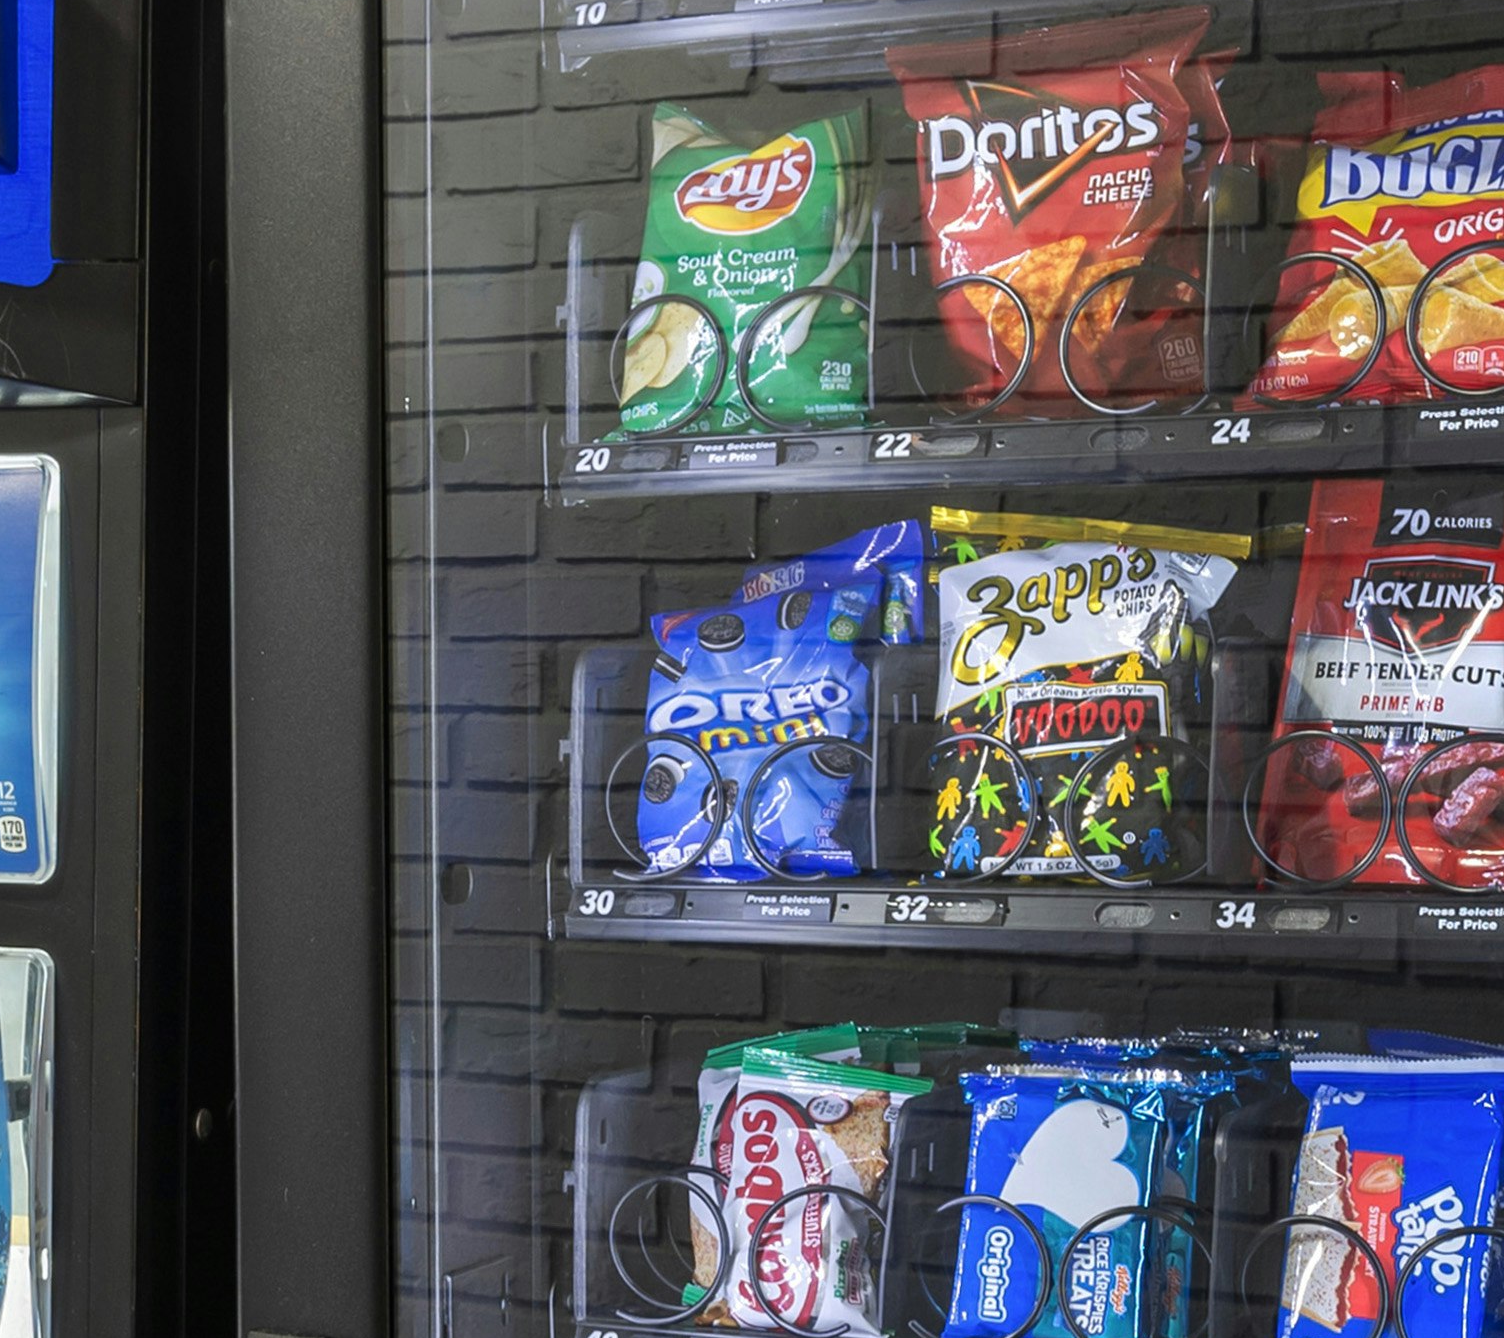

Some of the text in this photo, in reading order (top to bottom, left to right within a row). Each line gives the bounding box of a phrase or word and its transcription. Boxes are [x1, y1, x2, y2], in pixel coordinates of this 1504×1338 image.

[575, 3, 607, 26] 10
[930, 102, 1161, 175] Doritos
[680, 141, 805, 213] Lay's
[1088, 167, 1152, 188] NACHO
[1083, 183, 1154, 205] CHEESE
[678, 247, 796, 274] Sour Cream
[821, 361, 851, 377] 230
[1211, 418, 1251, 444] 24
[876, 433, 912, 458] 22
[576, 449, 610, 474] 20
[1390, 508, 1492, 537] 70 CALORIES
[1113, 584, 1157, 603] POTATO
[1344, 578, 1416, 609] JACK
[952, 547, 1158, 686] Zapp's
[1315, 662, 1360, 679] BEEF
[1366, 661, 1444, 680] TENDER
[648, 680, 849, 735] OREO
[698, 713, 829, 752] mini
[1014, 699, 1144, 745] VOODOO
[579, 891, 614, 916] 30
[892, 895, 928, 922] 32
[1216, 902, 1256, 928] 34
[1419, 906, 1455, 918] Press
[1438, 918, 1498, 932] For Price
[982, 1230, 1009, 1318] Original
[1088, 1237, 1111, 1334] RICE KRISPIES
